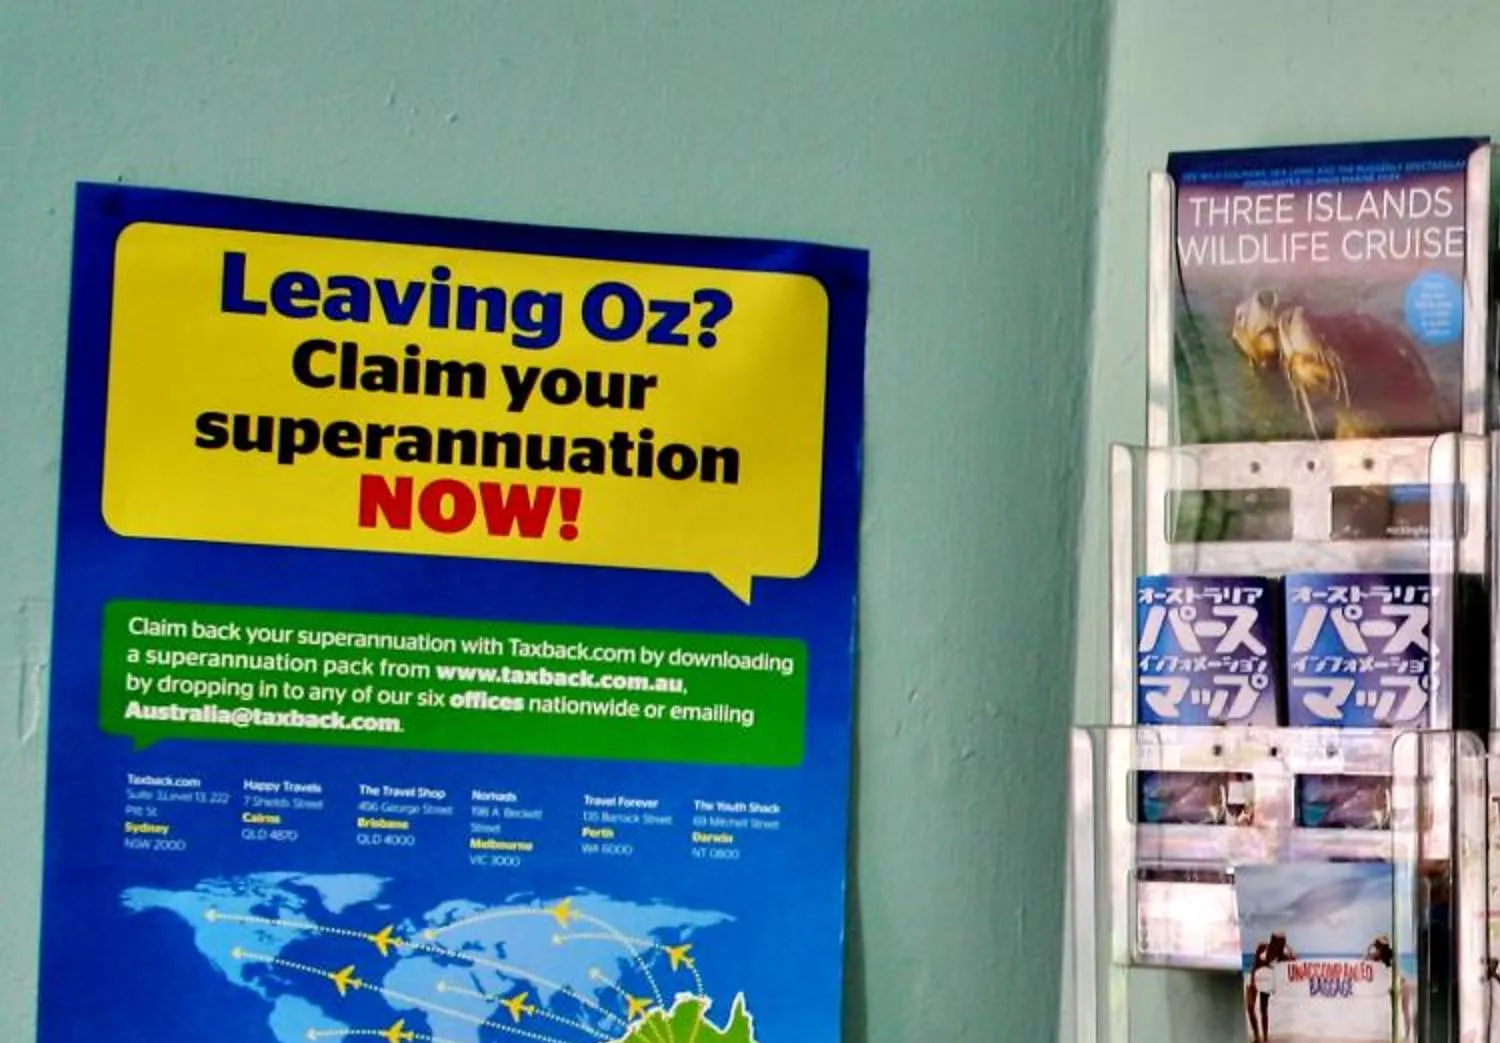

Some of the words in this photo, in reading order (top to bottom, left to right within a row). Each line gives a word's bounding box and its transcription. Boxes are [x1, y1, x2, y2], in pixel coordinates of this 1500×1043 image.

[1190, 193, 1295, 228] THREE
[1307, 187, 1453, 222] ISLANDS
[1178, 232, 1330, 266] WILDLIFE
[1342, 226, 1465, 261] CRUISE
[221, 251, 563, 349] Leaving
[582, 280, 733, 347] Oz?
[293, 339, 487, 398] Claim
[501, 360, 657, 413] your
[195, 410, 740, 485] superannuation
[358, 474, 583, 542] NOW!
[1139, 586, 1263, 605] オーストラリア
[128, 617, 187, 638] Claim
[192, 620, 240, 641] back
[246, 628, 295, 645] your
[298, 629, 457, 653] superannuation
[461, 637, 503, 656] with
[509, 638, 635, 663] Taxback.com
[640, 642, 665, 668] by
[668, 649, 794, 676] downloading
[1140, 605, 1267, 656] パース
[1292, 606, 1439, 656] パース
[127, 649, 139, 664] a
[145, 648, 317, 673] superannuation
[323, 659, 373, 677] pack
[379, 661, 431, 679] from
[125, 674, 152, 693] by
[157, 677, 254, 700] dropping
[258, 680, 278, 698] in
[283, 683, 303, 700] to
[309, 686, 347, 704] any
[352, 685, 372, 703] of
[377, 691, 411, 706] our
[417, 689, 444, 707] six
[450, 692, 524, 711] offices
[529, 696, 640, 718] nationwide
[644, 703, 666, 719] or
[670, 707, 754, 726] emailing
[1140, 674, 1269, 720] マップ
[1292, 675, 1439, 720] マップ
